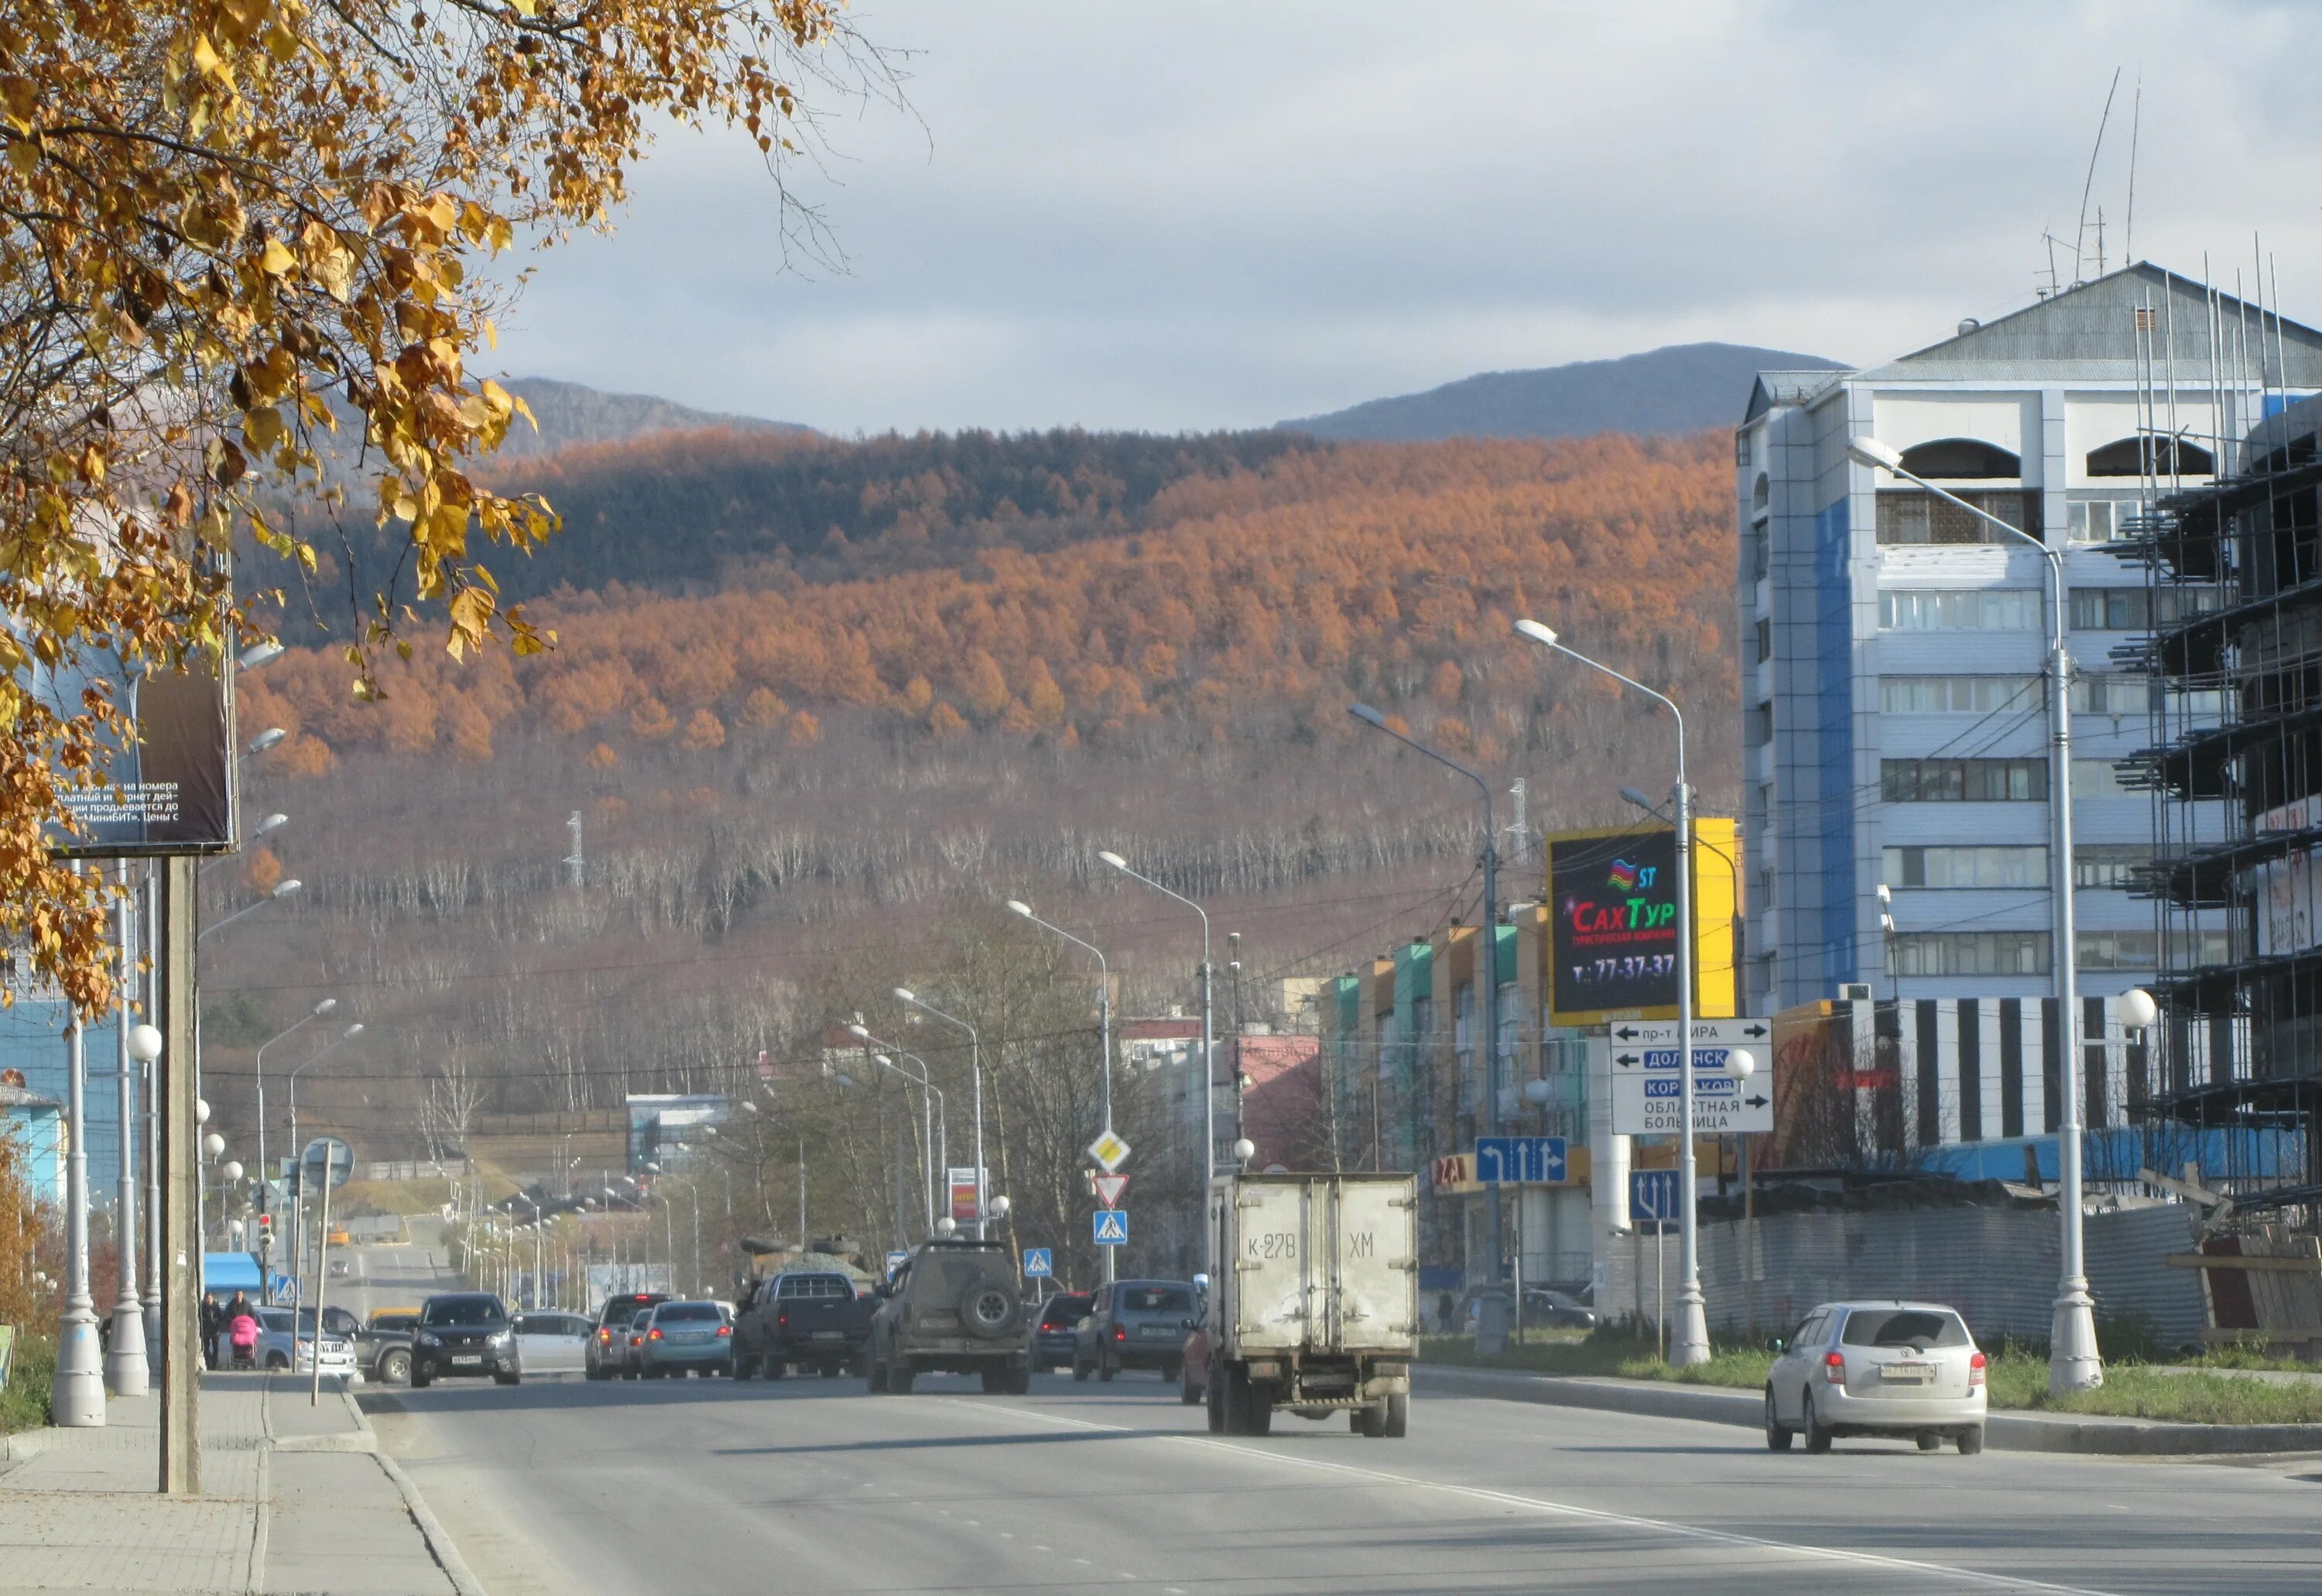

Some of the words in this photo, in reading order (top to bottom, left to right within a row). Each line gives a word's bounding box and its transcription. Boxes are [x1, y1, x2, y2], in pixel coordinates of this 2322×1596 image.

[124, 783, 136, 791] на
[139, 782, 178, 792] номера
[54, 792, 101, 803] платный
[90, 803, 163, 813] продлевается
[165, 802, 179, 812] до
[143, 812, 170, 823] Цены
[1639, 866, 1657, 888] ST
[1595, 954, 1674, 982] 77-37-37
[1642, 1029, 1671, 1042] пр-т
[1677, 1026, 1718, 1039] ИРА
[1649, 1052, 1724, 1067] ДОЛНСК
